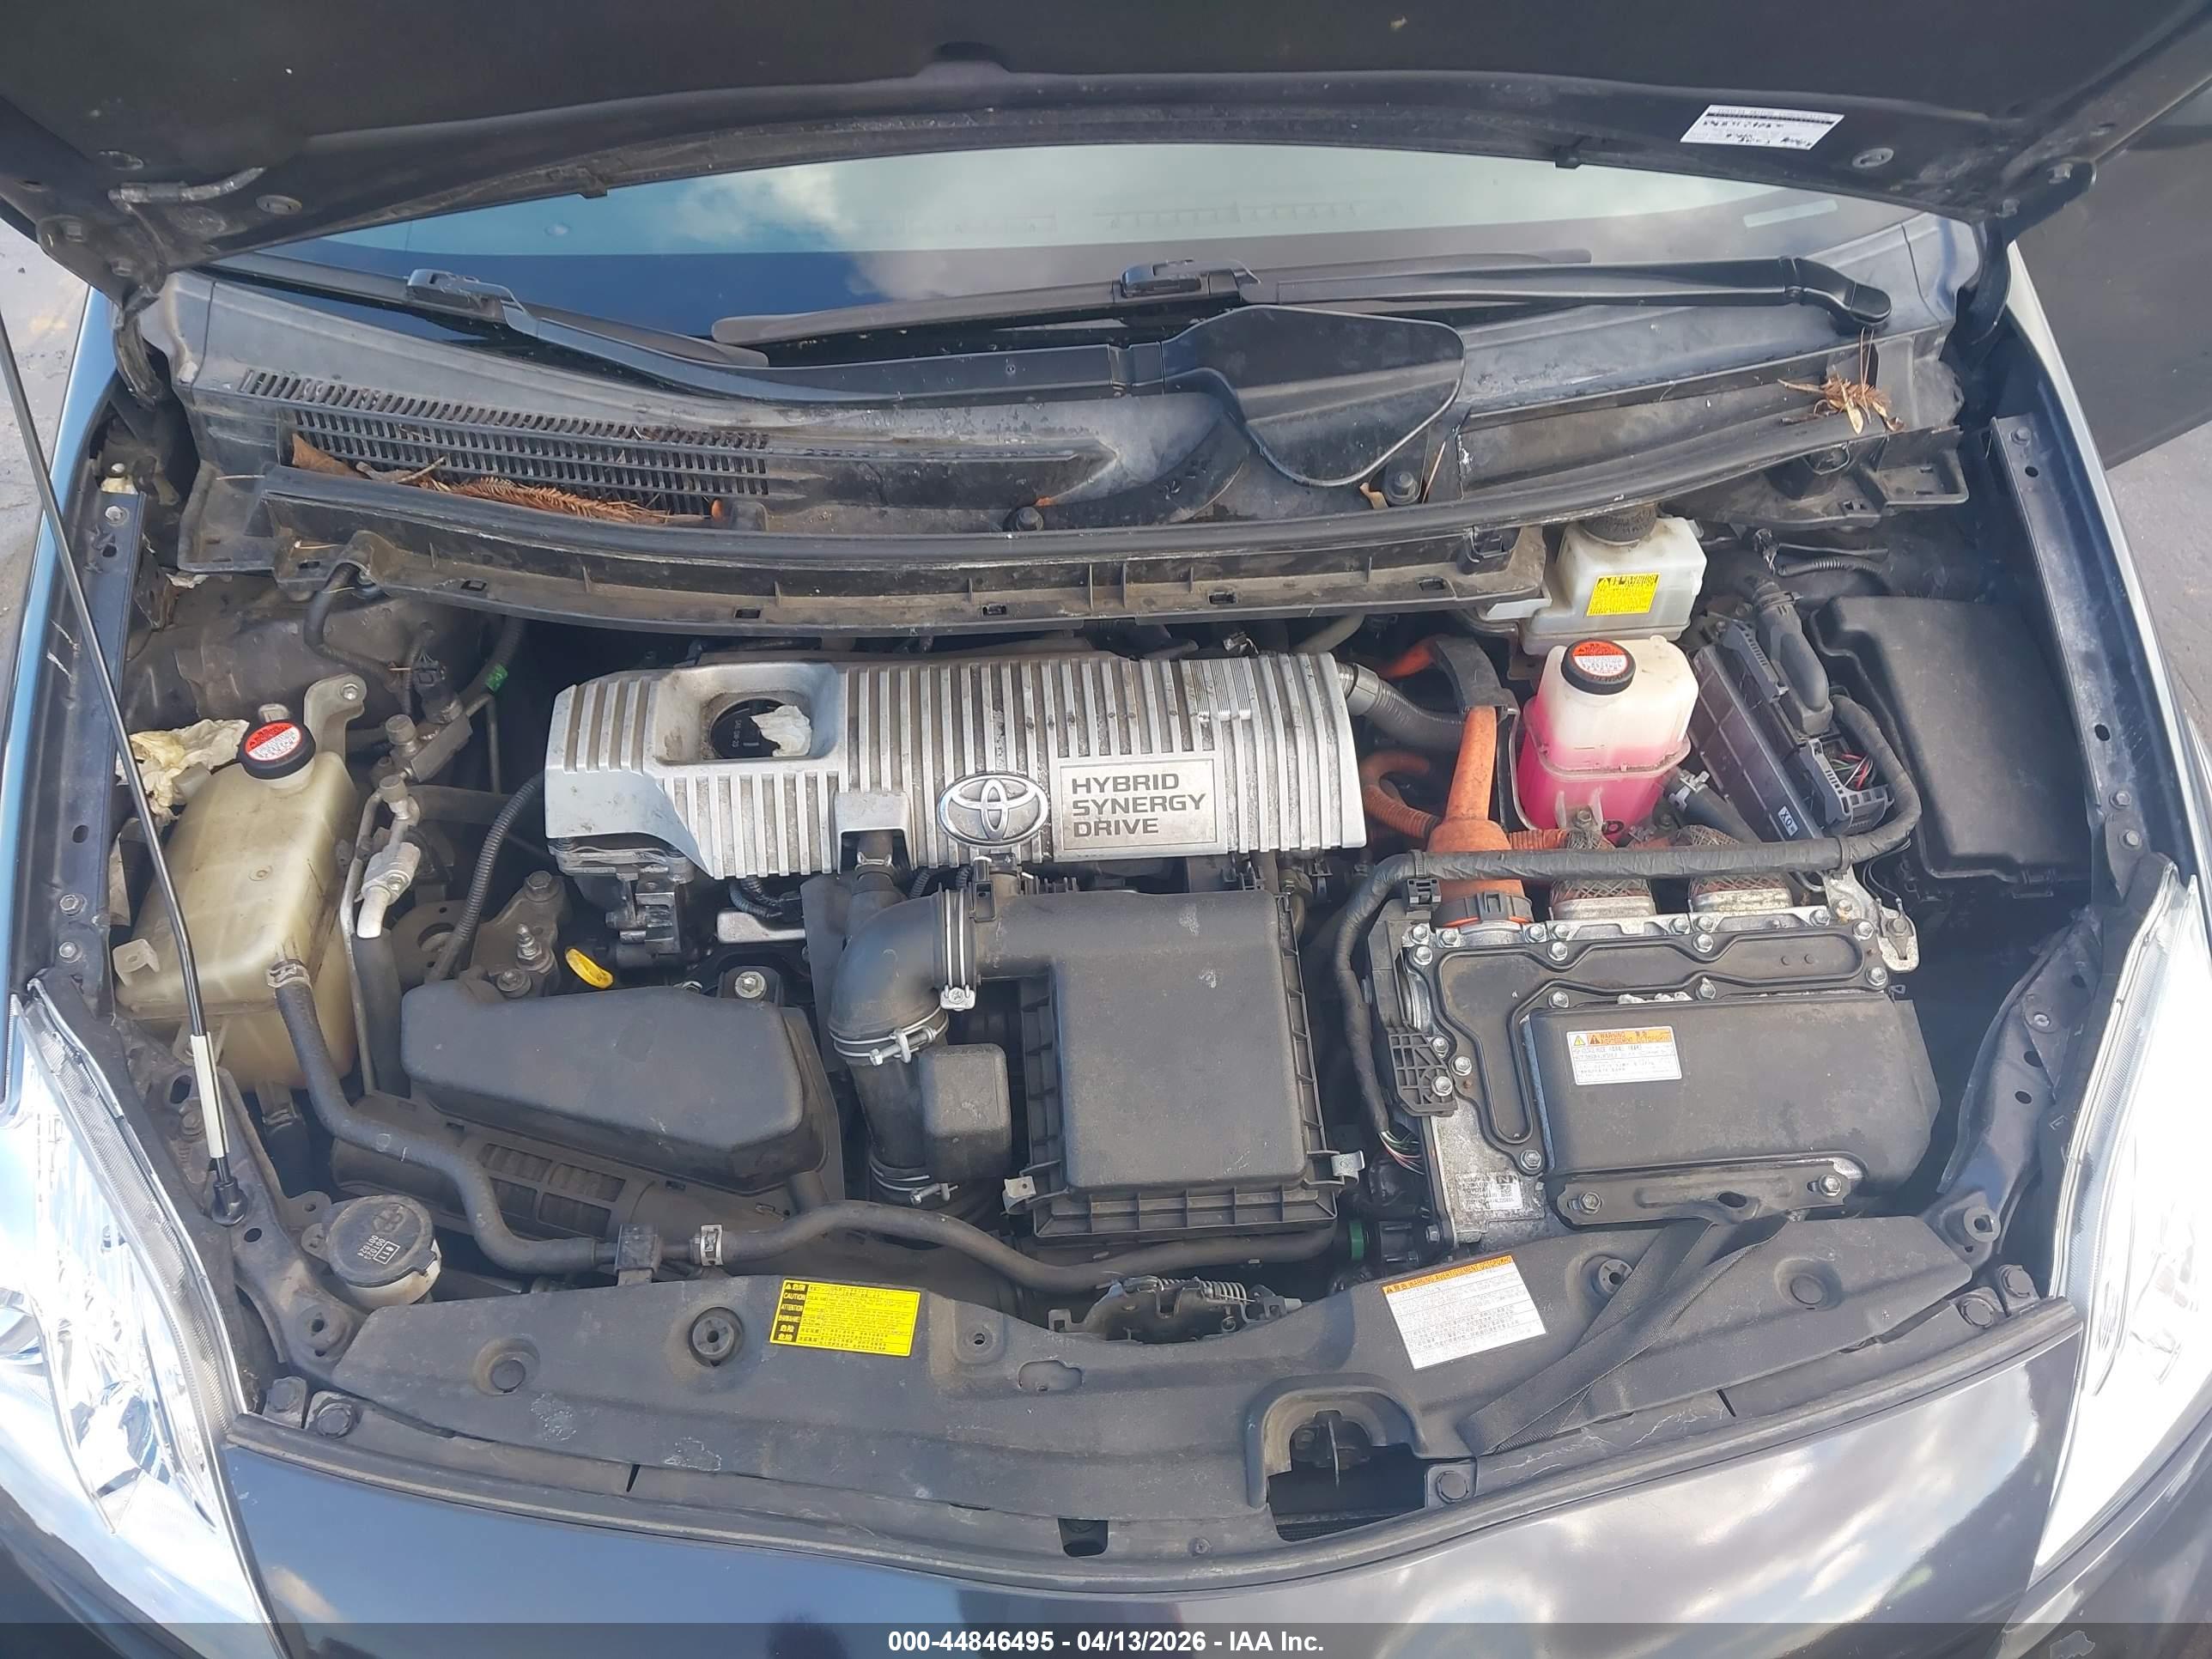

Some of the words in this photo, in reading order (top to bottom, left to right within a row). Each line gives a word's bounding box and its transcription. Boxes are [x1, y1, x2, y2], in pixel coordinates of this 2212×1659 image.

[1072, 773, 1180, 795] HYBRID
[1073, 793, 1206, 817] SYNERGY
[1073, 817, 1159, 837] DRIVE
[783, 1292, 806, 1301] CAUTION
[781, 1304, 804, 1312] ATTENTION
